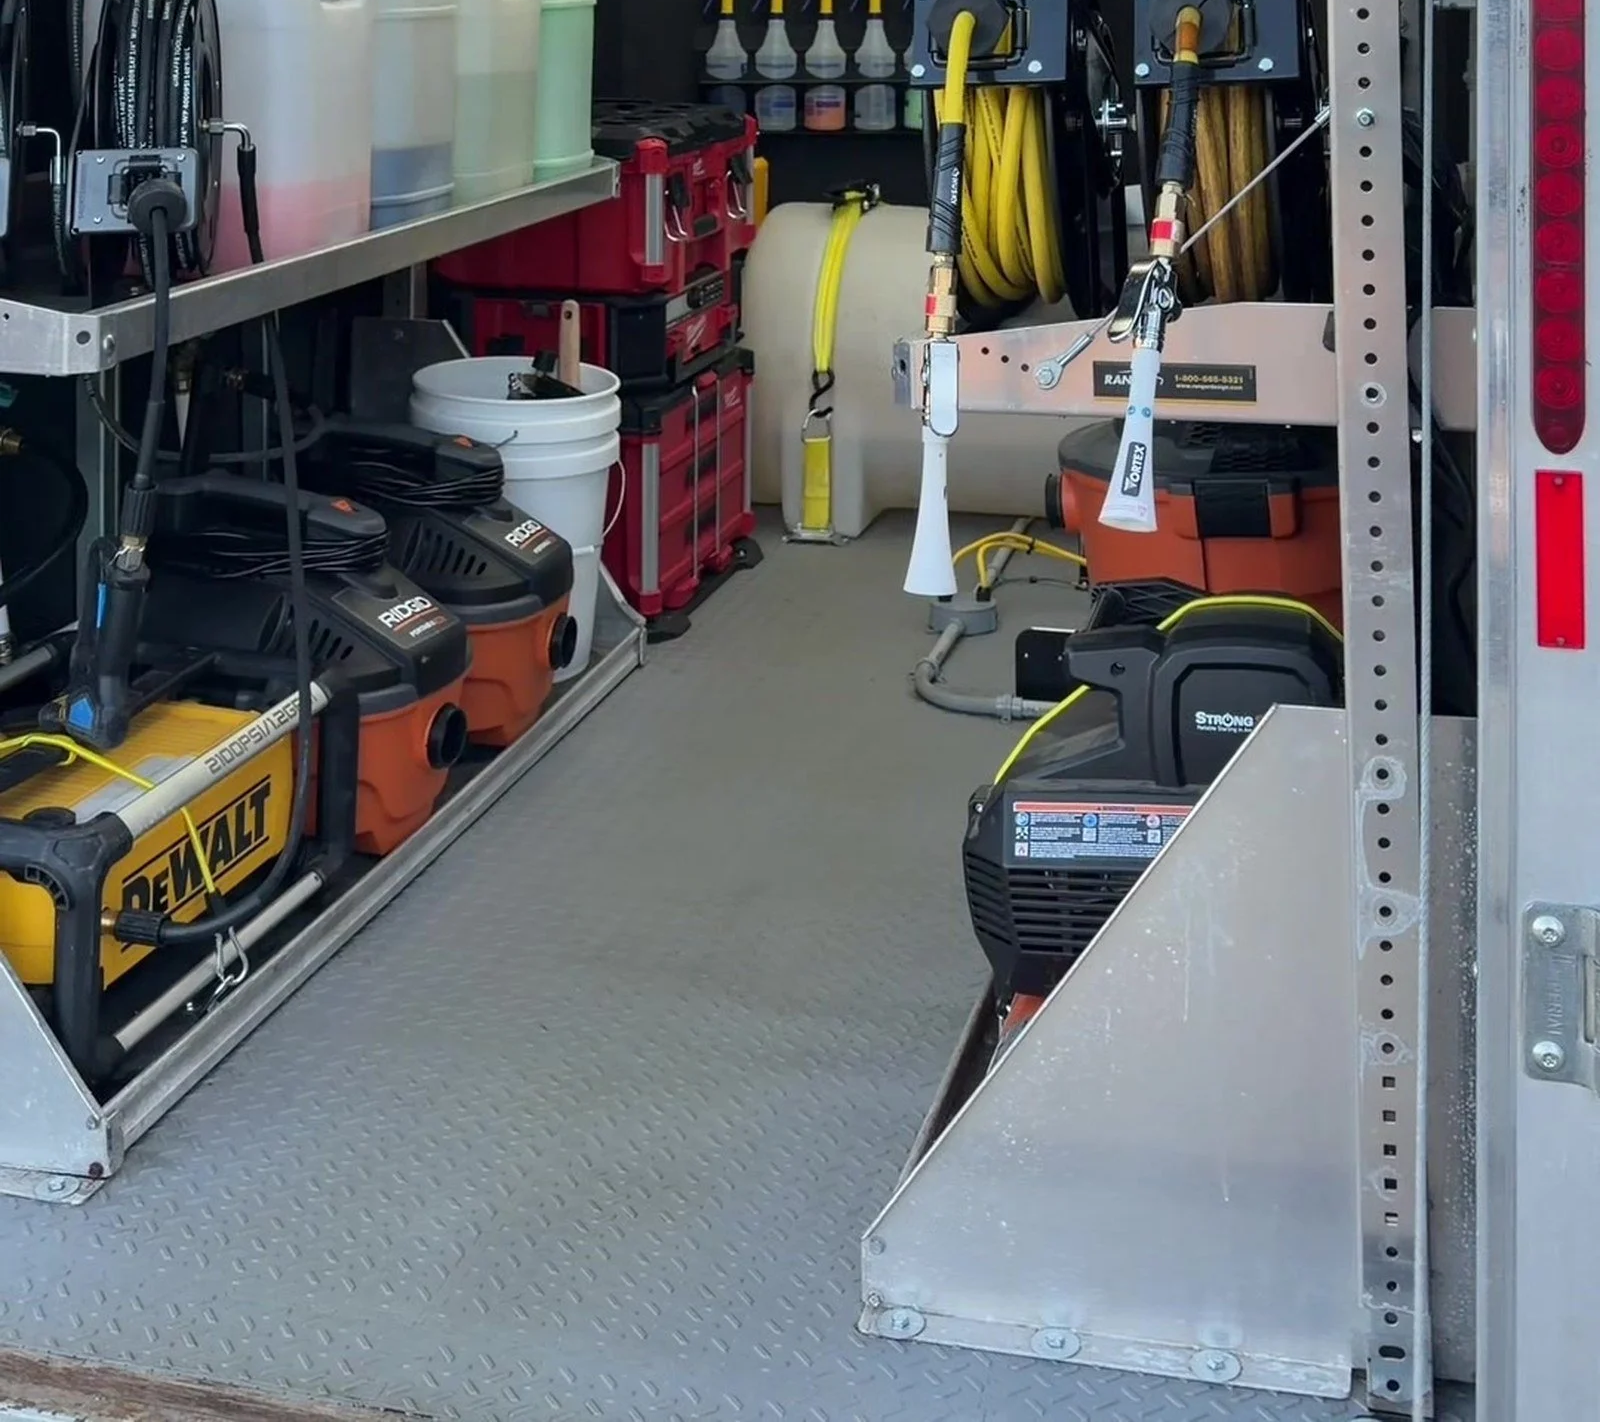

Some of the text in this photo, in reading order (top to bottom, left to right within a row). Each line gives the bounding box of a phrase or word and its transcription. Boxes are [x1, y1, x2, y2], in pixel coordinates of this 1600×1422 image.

[128, 104, 136, 125] HOSE
[128, 125, 136, 149] AULIC
[1104, 374, 1132, 385] RAN
[1124, 445, 1145, 491] VORTEX
[504, 519, 542, 547] RIDGID
[378, 596, 432, 628] RIDGID
[1195, 711, 1254, 727] STRONG
[205, 695, 317, 774] 2100PSI/1.2GP
